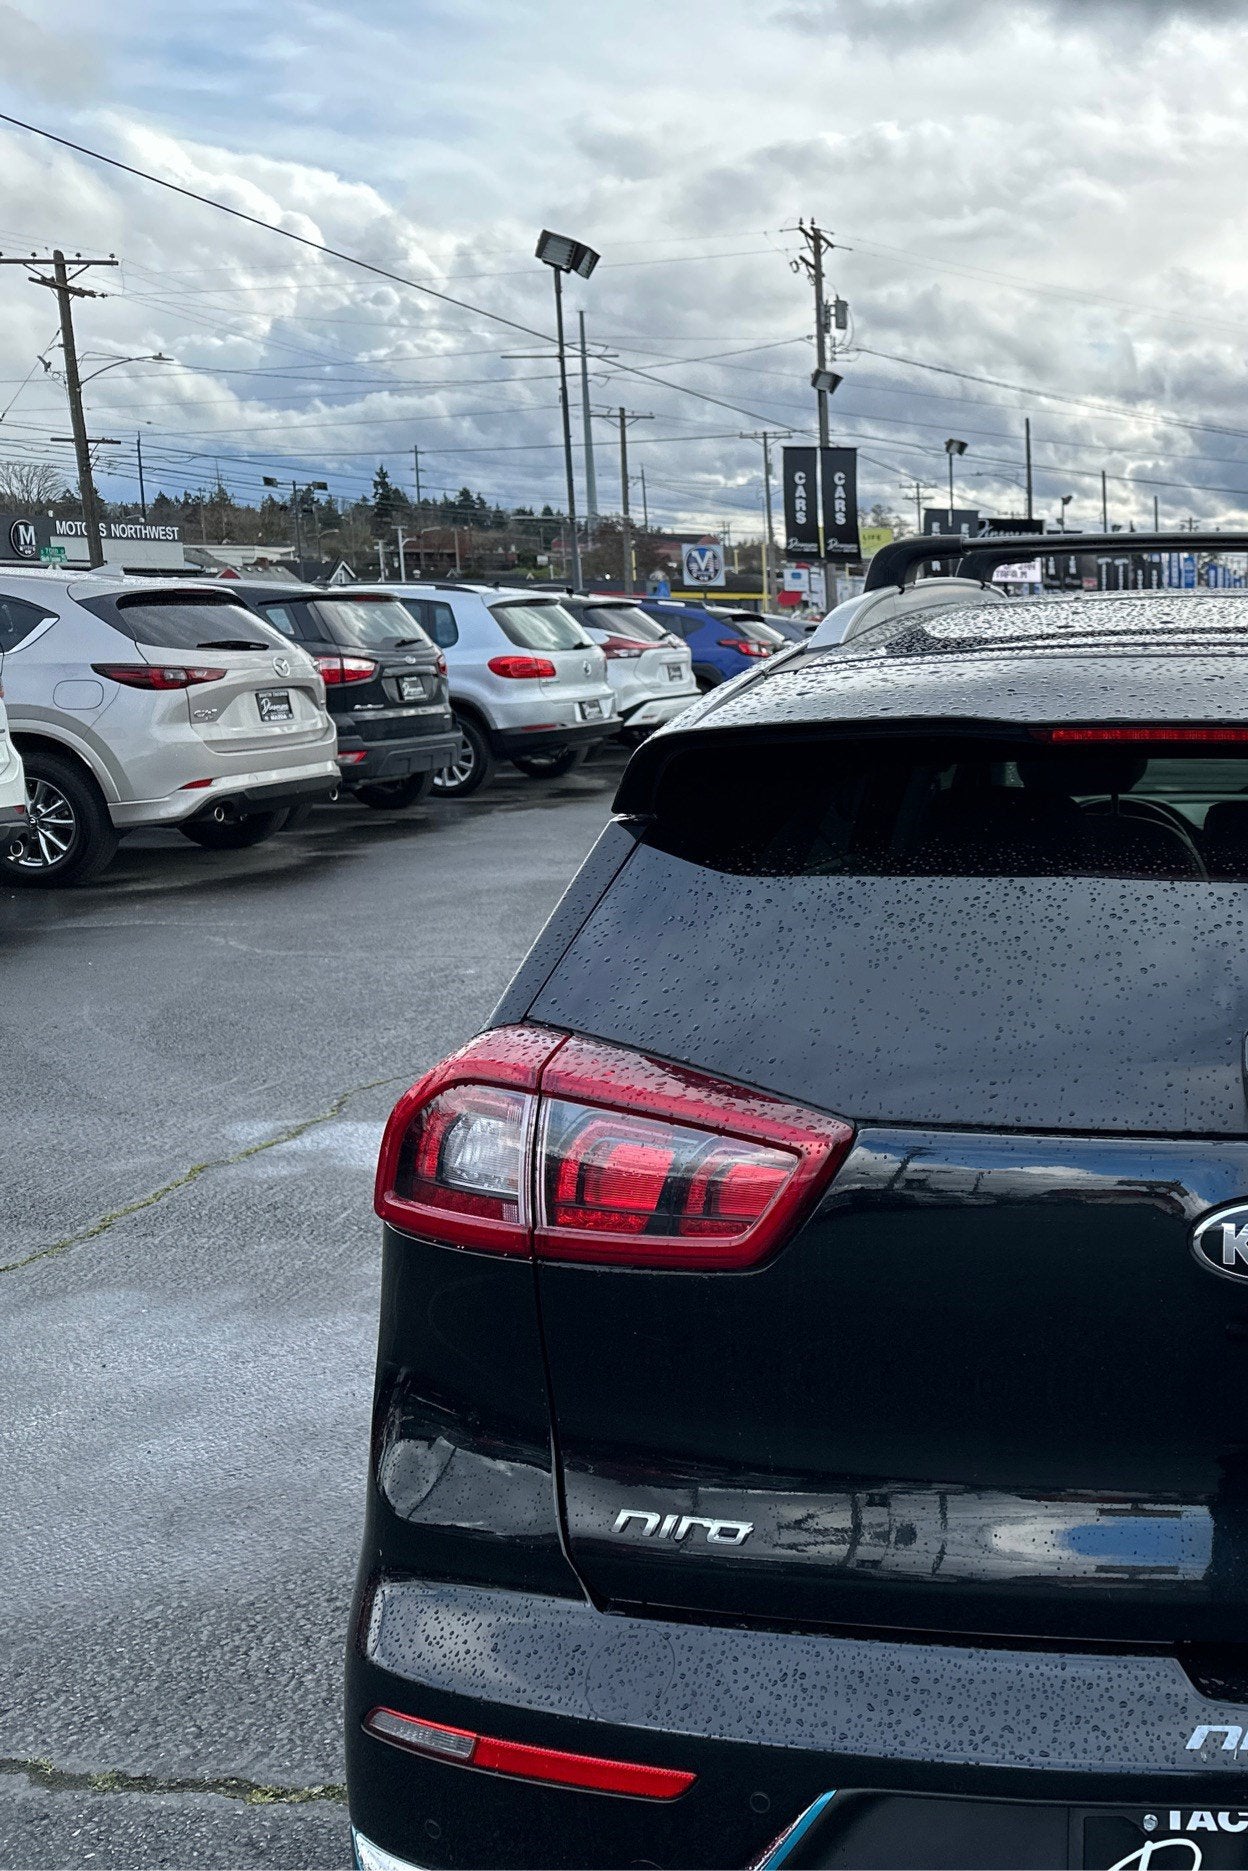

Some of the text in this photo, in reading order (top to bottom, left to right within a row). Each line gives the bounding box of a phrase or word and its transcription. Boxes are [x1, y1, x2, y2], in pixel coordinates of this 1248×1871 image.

[794, 471, 807, 525] CARS
[834, 472, 847, 526] CARS
[19, 525, 36, 545] M
[56, 520, 179, 540] MOTOS NORTHWEST
